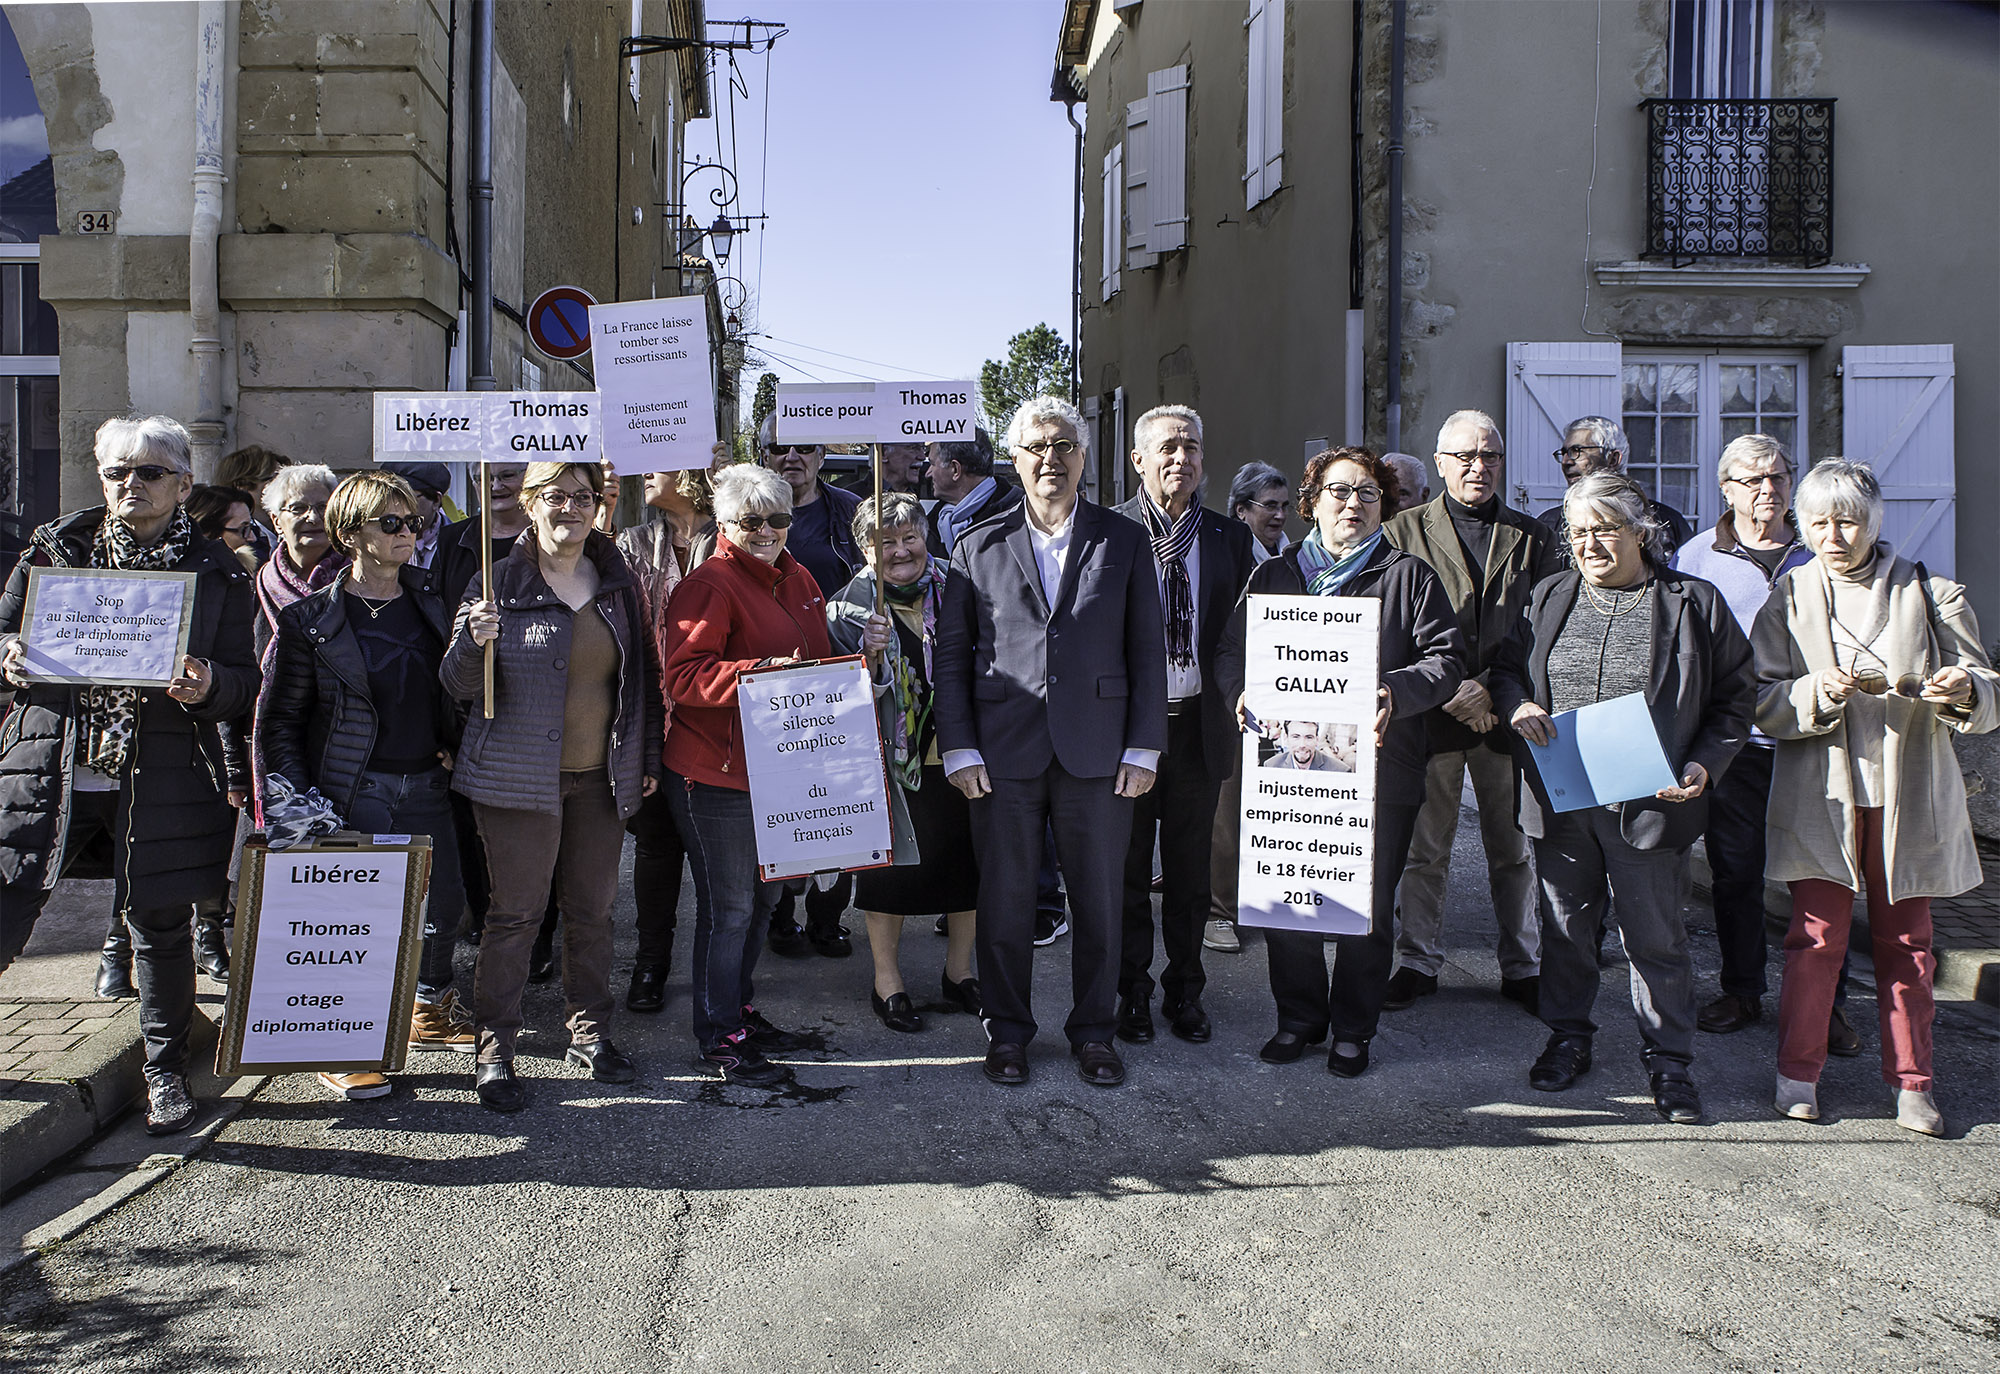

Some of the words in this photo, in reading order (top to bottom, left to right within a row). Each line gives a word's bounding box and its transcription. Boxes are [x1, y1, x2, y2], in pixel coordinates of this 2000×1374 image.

[82, 214, 109, 232] 34
[603, 323, 618, 334] La
[622, 320, 658, 332] France
[662, 317, 692, 328] laisse
[620, 336, 658, 348] tomber
[662, 334, 679, 343] ses
[614, 350, 688, 365] ressortissants
[899, 390, 967, 405] Thomas
[510, 400, 588, 417] Thomas
[624, 400, 688, 416] Injustement
[782, 404, 833, 417] Justice
[838, 405, 873, 419] pour
[396, 412, 470, 431] Libérez
[628, 417, 670, 429] détenus
[673, 416, 686, 425] au
[901, 420, 967, 435] GALLAY
[510, 435, 588, 451] GALLAY
[641, 432, 677, 444] Maroc
[95, 595, 123, 609] Stop
[47, 613, 61, 621] au
[65, 611, 109, 623] silence
[112, 615, 166, 627] complice
[1263, 607, 1318, 622] Justice
[1324, 611, 1362, 625] pour
[57, 628, 70, 638] de
[75, 629, 85, 639] la
[88, 630, 152, 642] diplomatie
[75, 645, 128, 658] française
[1274, 645, 1349, 662] Thomas
[1276, 677, 1348, 694] GALLAY
[770, 693, 815, 711] STOP
[826, 692, 843, 704] au
[782, 714, 835, 731] silence
[777, 733, 846, 753] complice
[808, 784, 827, 798] du
[1259, 780, 1358, 800] injustement
[767, 800, 875, 828] gouvernement
[1246, 808, 1343, 826] emprisonné
[1349, 817, 1368, 828] au
[793, 823, 853, 842] français
[1251, 835, 1303, 851] Maroc
[1308, 839, 1363, 857] depuis
[291, 864, 380, 883] Libérez
[1257, 861, 1271, 874] le
[1277, 863, 1295, 877] 18
[1300, 865, 1355, 882] février
[1284, 891, 1323, 906] 2016
[288, 921, 370, 936] Thomas
[286, 950, 367, 965] GALLAY
[286, 993, 344, 1009] otage
[251, 1019, 374, 1035] diplomatique
